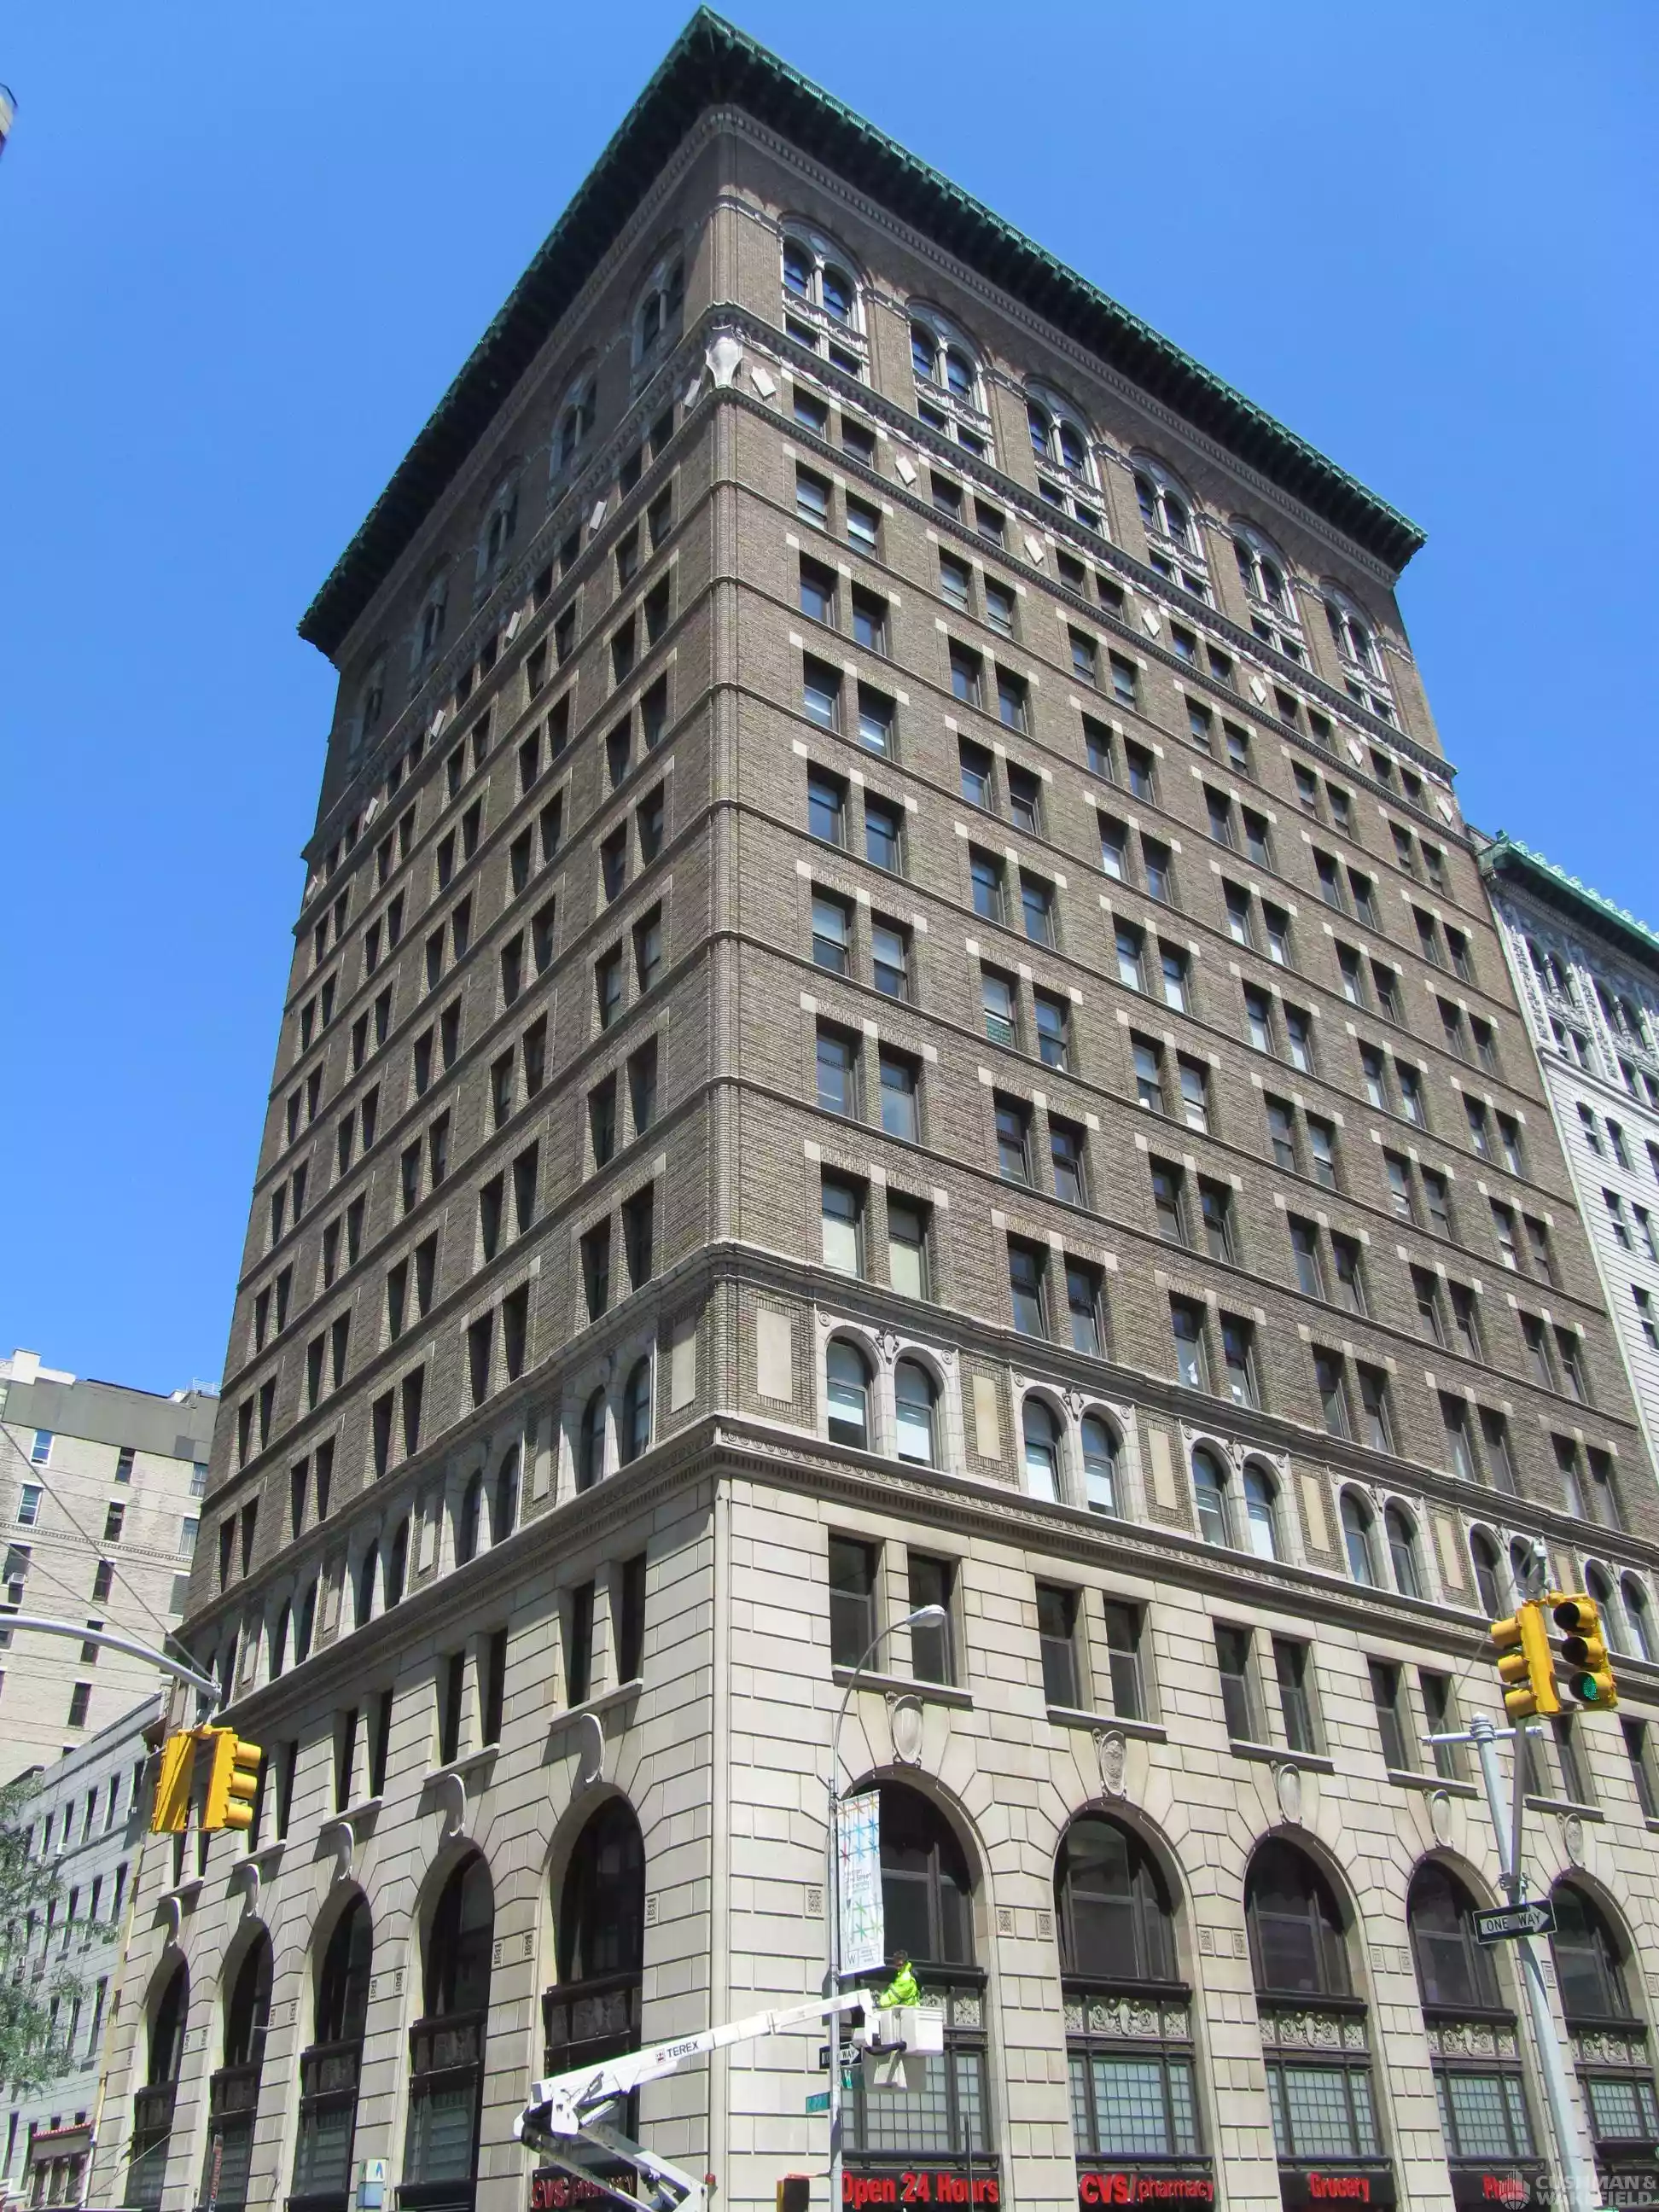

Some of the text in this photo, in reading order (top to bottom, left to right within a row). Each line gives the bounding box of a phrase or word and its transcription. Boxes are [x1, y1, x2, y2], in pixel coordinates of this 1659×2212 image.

[1487, 1912, 1541, 1931] ONE WAY
[667, 2040, 699, 2058] TEREX
[841, 2050, 856, 2060] WAY
[841, 2171, 999, 2209] Open 24 Hours
[1307, 2171, 1371, 2203] Grocery
